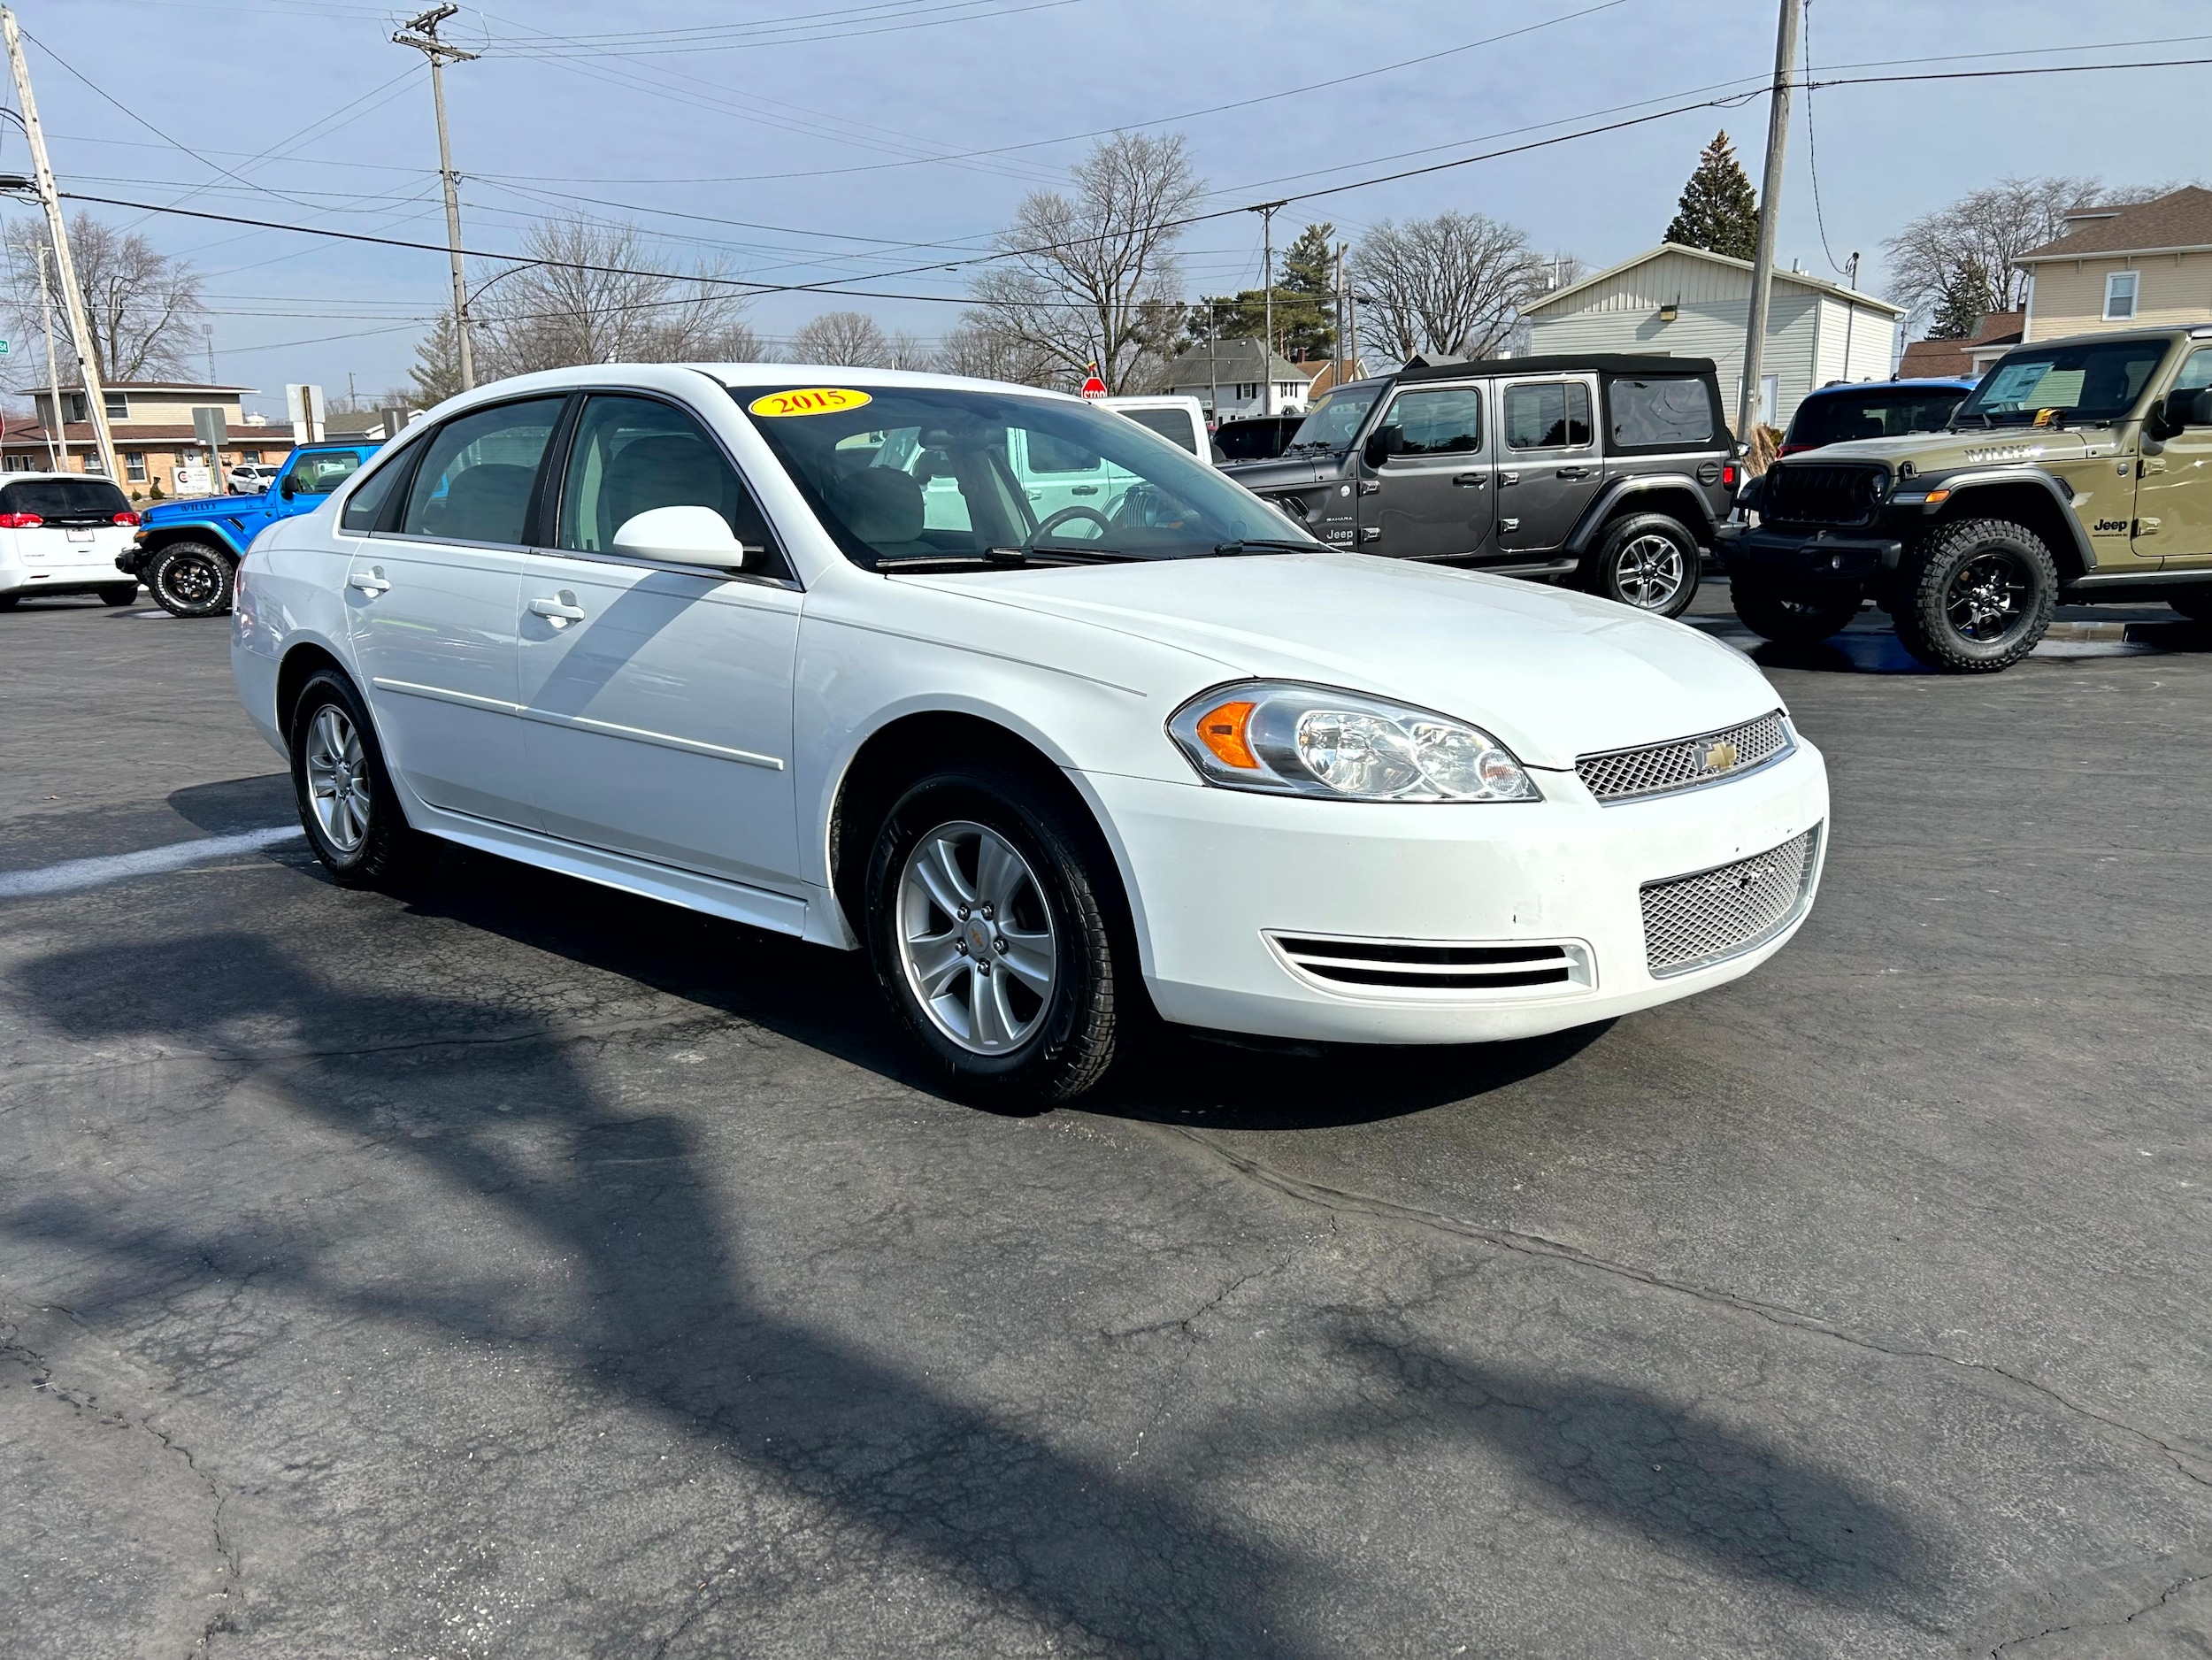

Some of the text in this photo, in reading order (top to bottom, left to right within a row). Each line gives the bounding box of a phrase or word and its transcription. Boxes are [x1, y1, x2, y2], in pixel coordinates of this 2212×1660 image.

[772, 390, 847, 414] 2015
[180, 503, 218, 512] WILLYS
[2093, 519, 2128, 532] Jeep
[1326, 529, 1354, 540] Jeep
